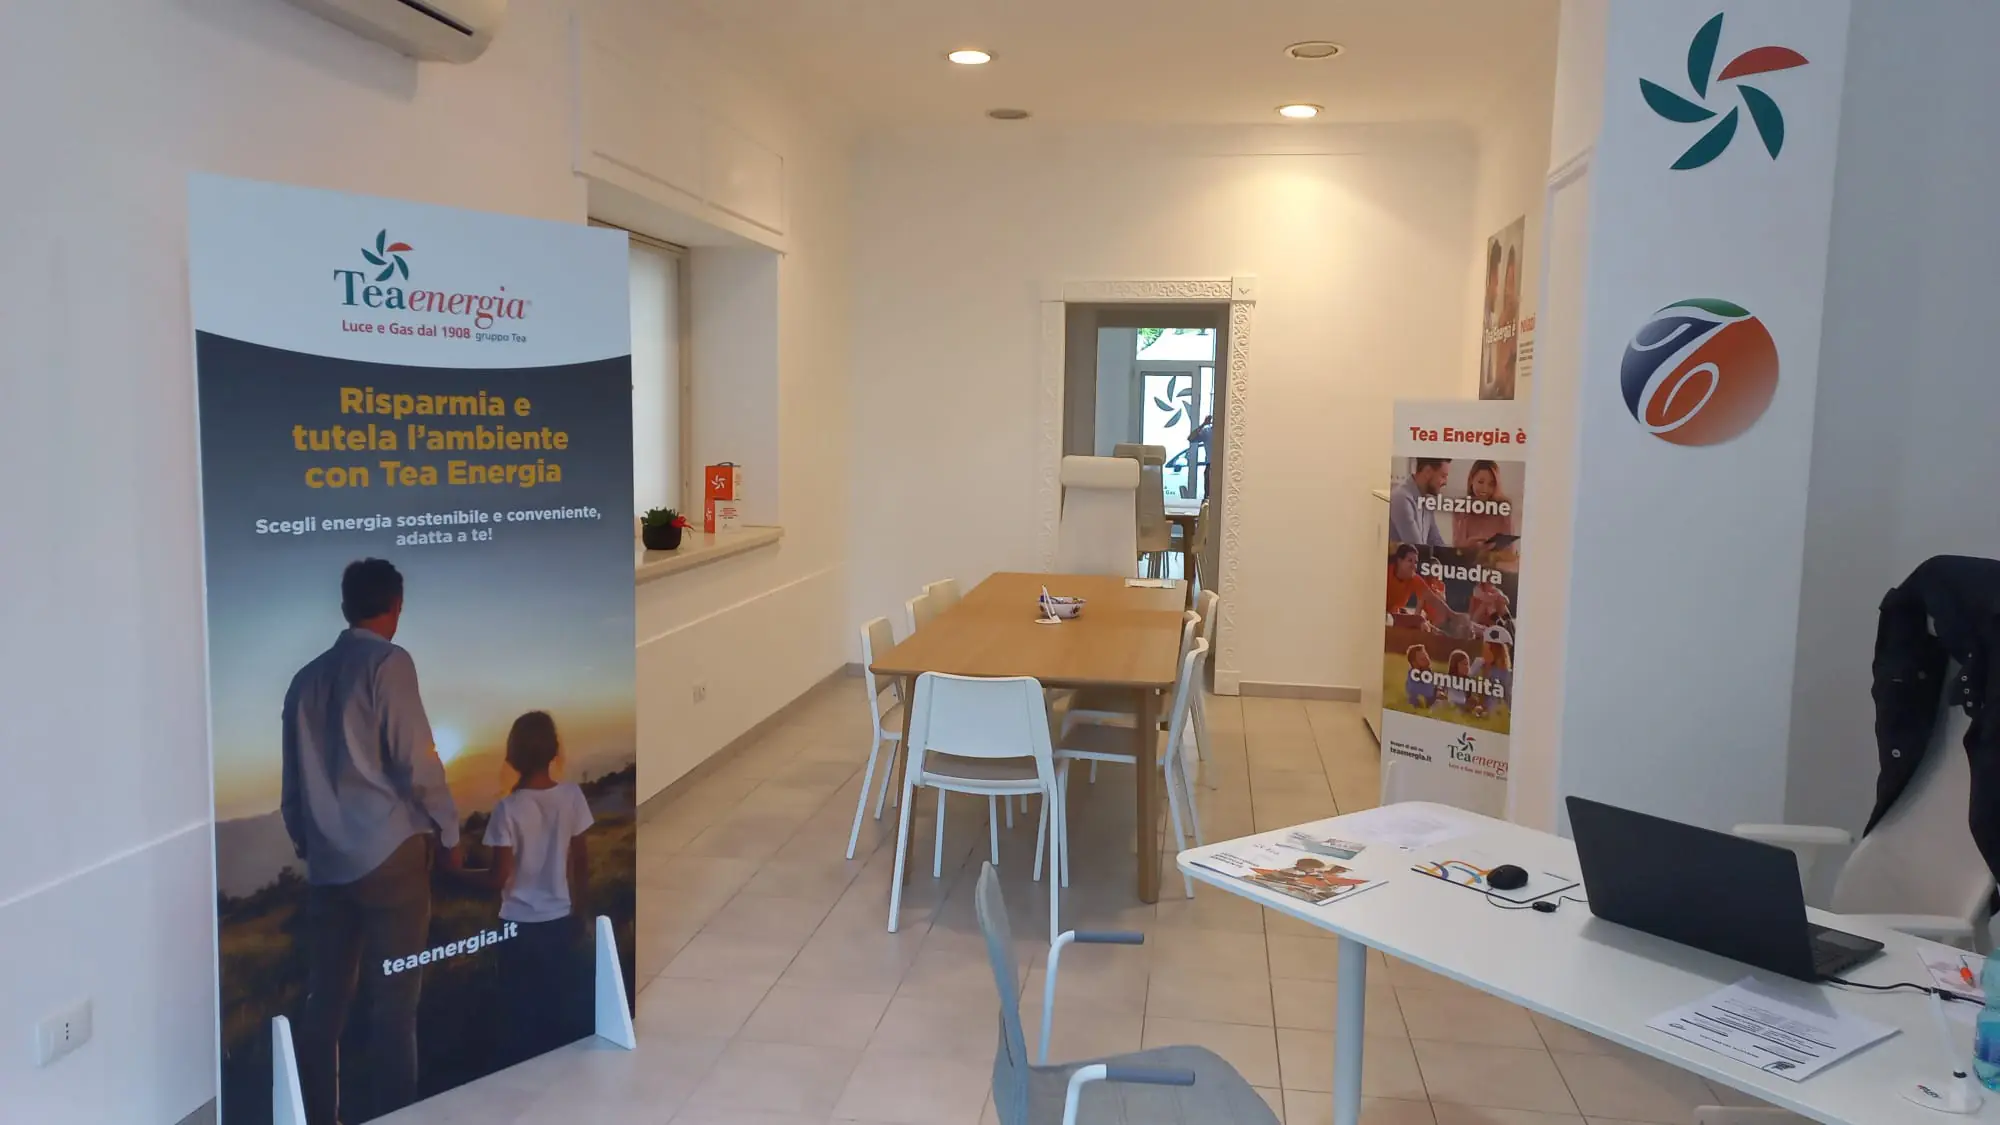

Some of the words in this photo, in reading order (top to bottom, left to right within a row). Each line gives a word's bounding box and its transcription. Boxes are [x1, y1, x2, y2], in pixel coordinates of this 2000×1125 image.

[342, 319, 373, 333] Luce
[377, 324, 385, 333] e
[389, 322, 413, 336] Gas
[417, 325, 437, 337] dal
[442, 327, 471, 339] 1908
[475, 331, 509, 342] gruppo
[511, 333, 527, 343] Tea
[340, 386, 505, 420] Risparmia
[514, 396, 532, 416] e
[292, 423, 397, 451] tutela
[1410, 426, 1438, 441] Tea
[1443, 427, 1510, 446] Energia
[1516, 428, 1527, 444] è
[305, 465, 369, 488] con
[379, 460, 438, 487] Tea
[448, 458, 561, 488] Energia
[1417, 494, 1512, 516] relazione
[255, 516, 316, 535] Scegli
[322, 514, 392, 531] energia
[396, 509, 488, 527] sostenibile
[493, 512, 502, 523] e
[507, 506, 601, 522] conveniente,
[396, 530, 453, 546] adatta
[457, 531, 467, 542] a
[471, 528, 493, 541] te!
[1420, 562, 1502, 585] squadra
[1410, 668, 1505, 698] comunità
[383, 921, 518, 976] teaenergia.it
